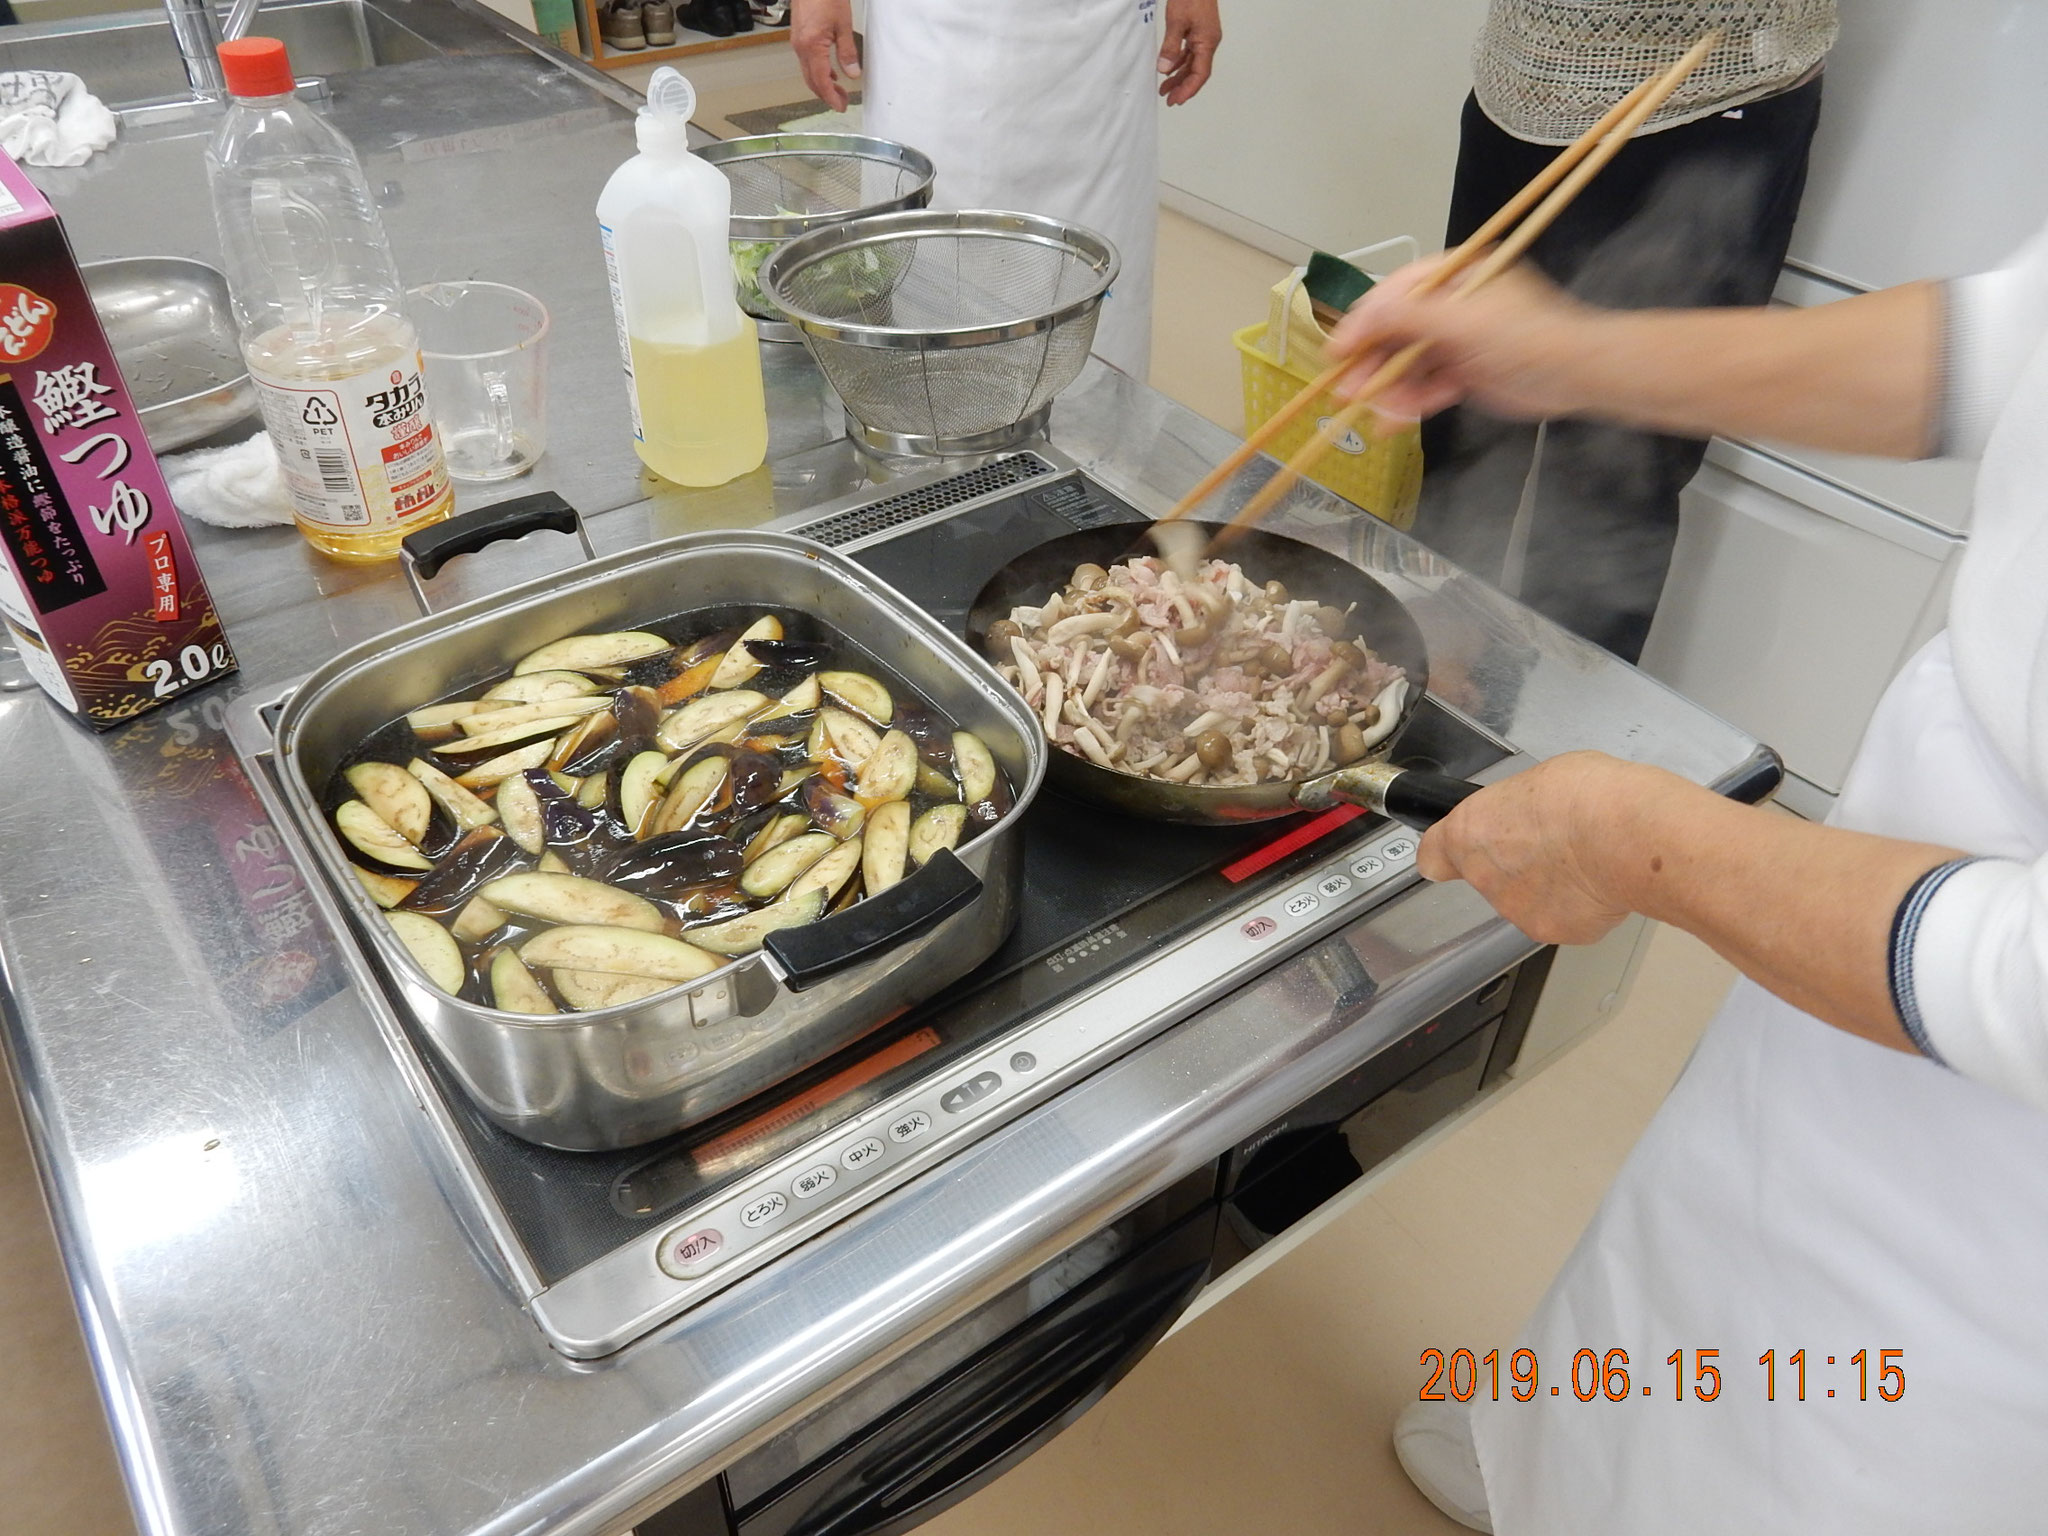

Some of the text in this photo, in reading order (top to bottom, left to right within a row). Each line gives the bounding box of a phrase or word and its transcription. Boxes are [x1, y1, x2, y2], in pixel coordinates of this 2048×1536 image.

[365, 372, 421, 413] タカラ
[32, 361, 149, 546] 鰹つゆ
[149, 533, 176, 613] プロ専用
[1289, 896, 1317, 914] とろ火
[1356, 859, 1379, 874] 中火
[747, 1196, 783, 1222] とろ火
[799, 1170, 830, 1192] 弱火
[848, 1142, 878, 1162] 中火
[895, 1116, 925, 1138] 強火
